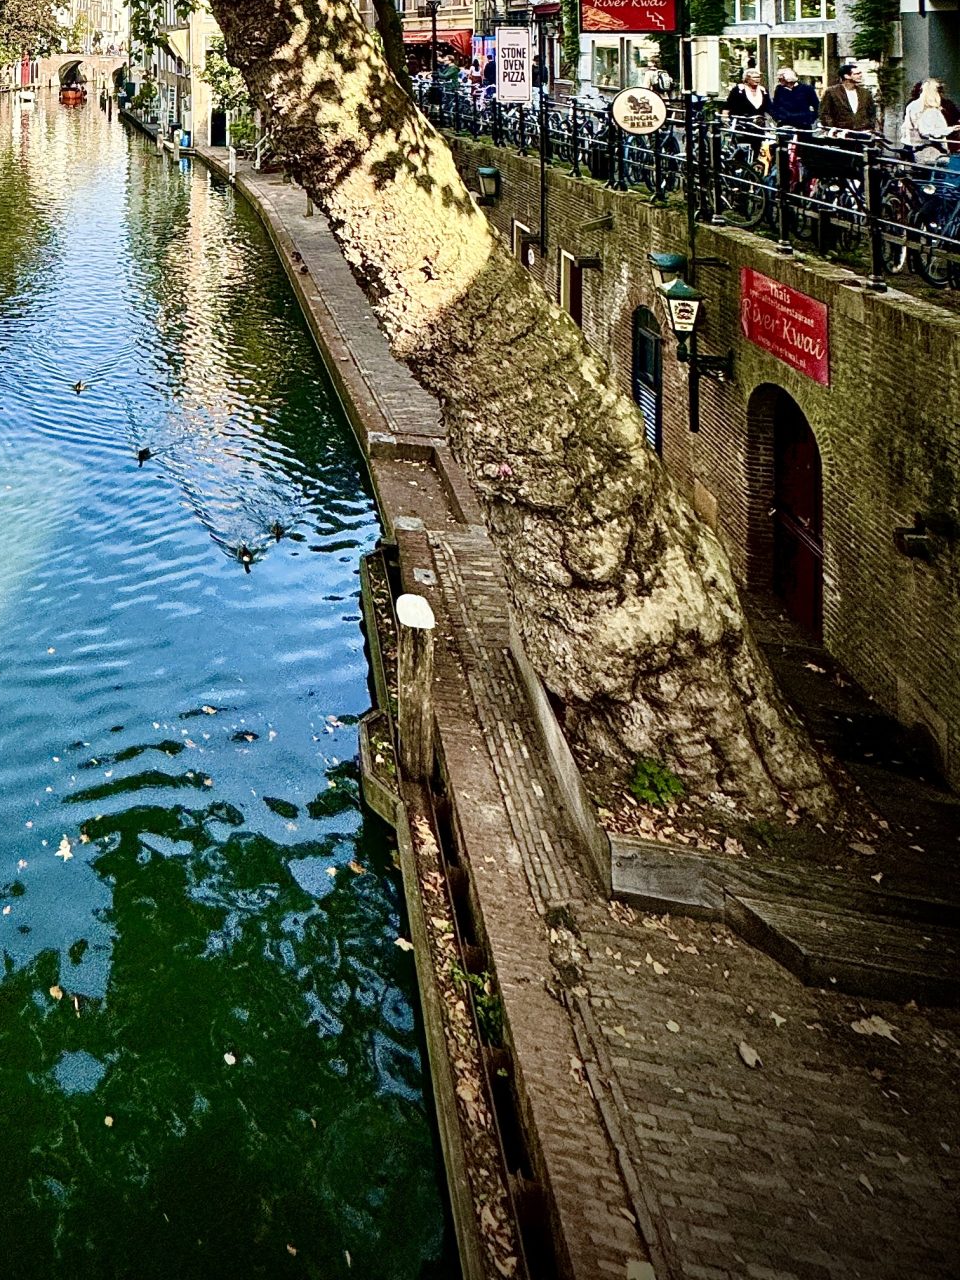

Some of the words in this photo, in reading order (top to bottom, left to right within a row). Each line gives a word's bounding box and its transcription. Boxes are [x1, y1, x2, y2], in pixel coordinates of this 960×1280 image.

[501, 47, 527, 59] STONE
[503, 59, 525, 71] OVEN
[502, 71, 526, 83] PIZZA
[768, 282, 791, 304] Thais
[741, 298, 780, 333] River
[782, 317, 826, 360] Kwai
